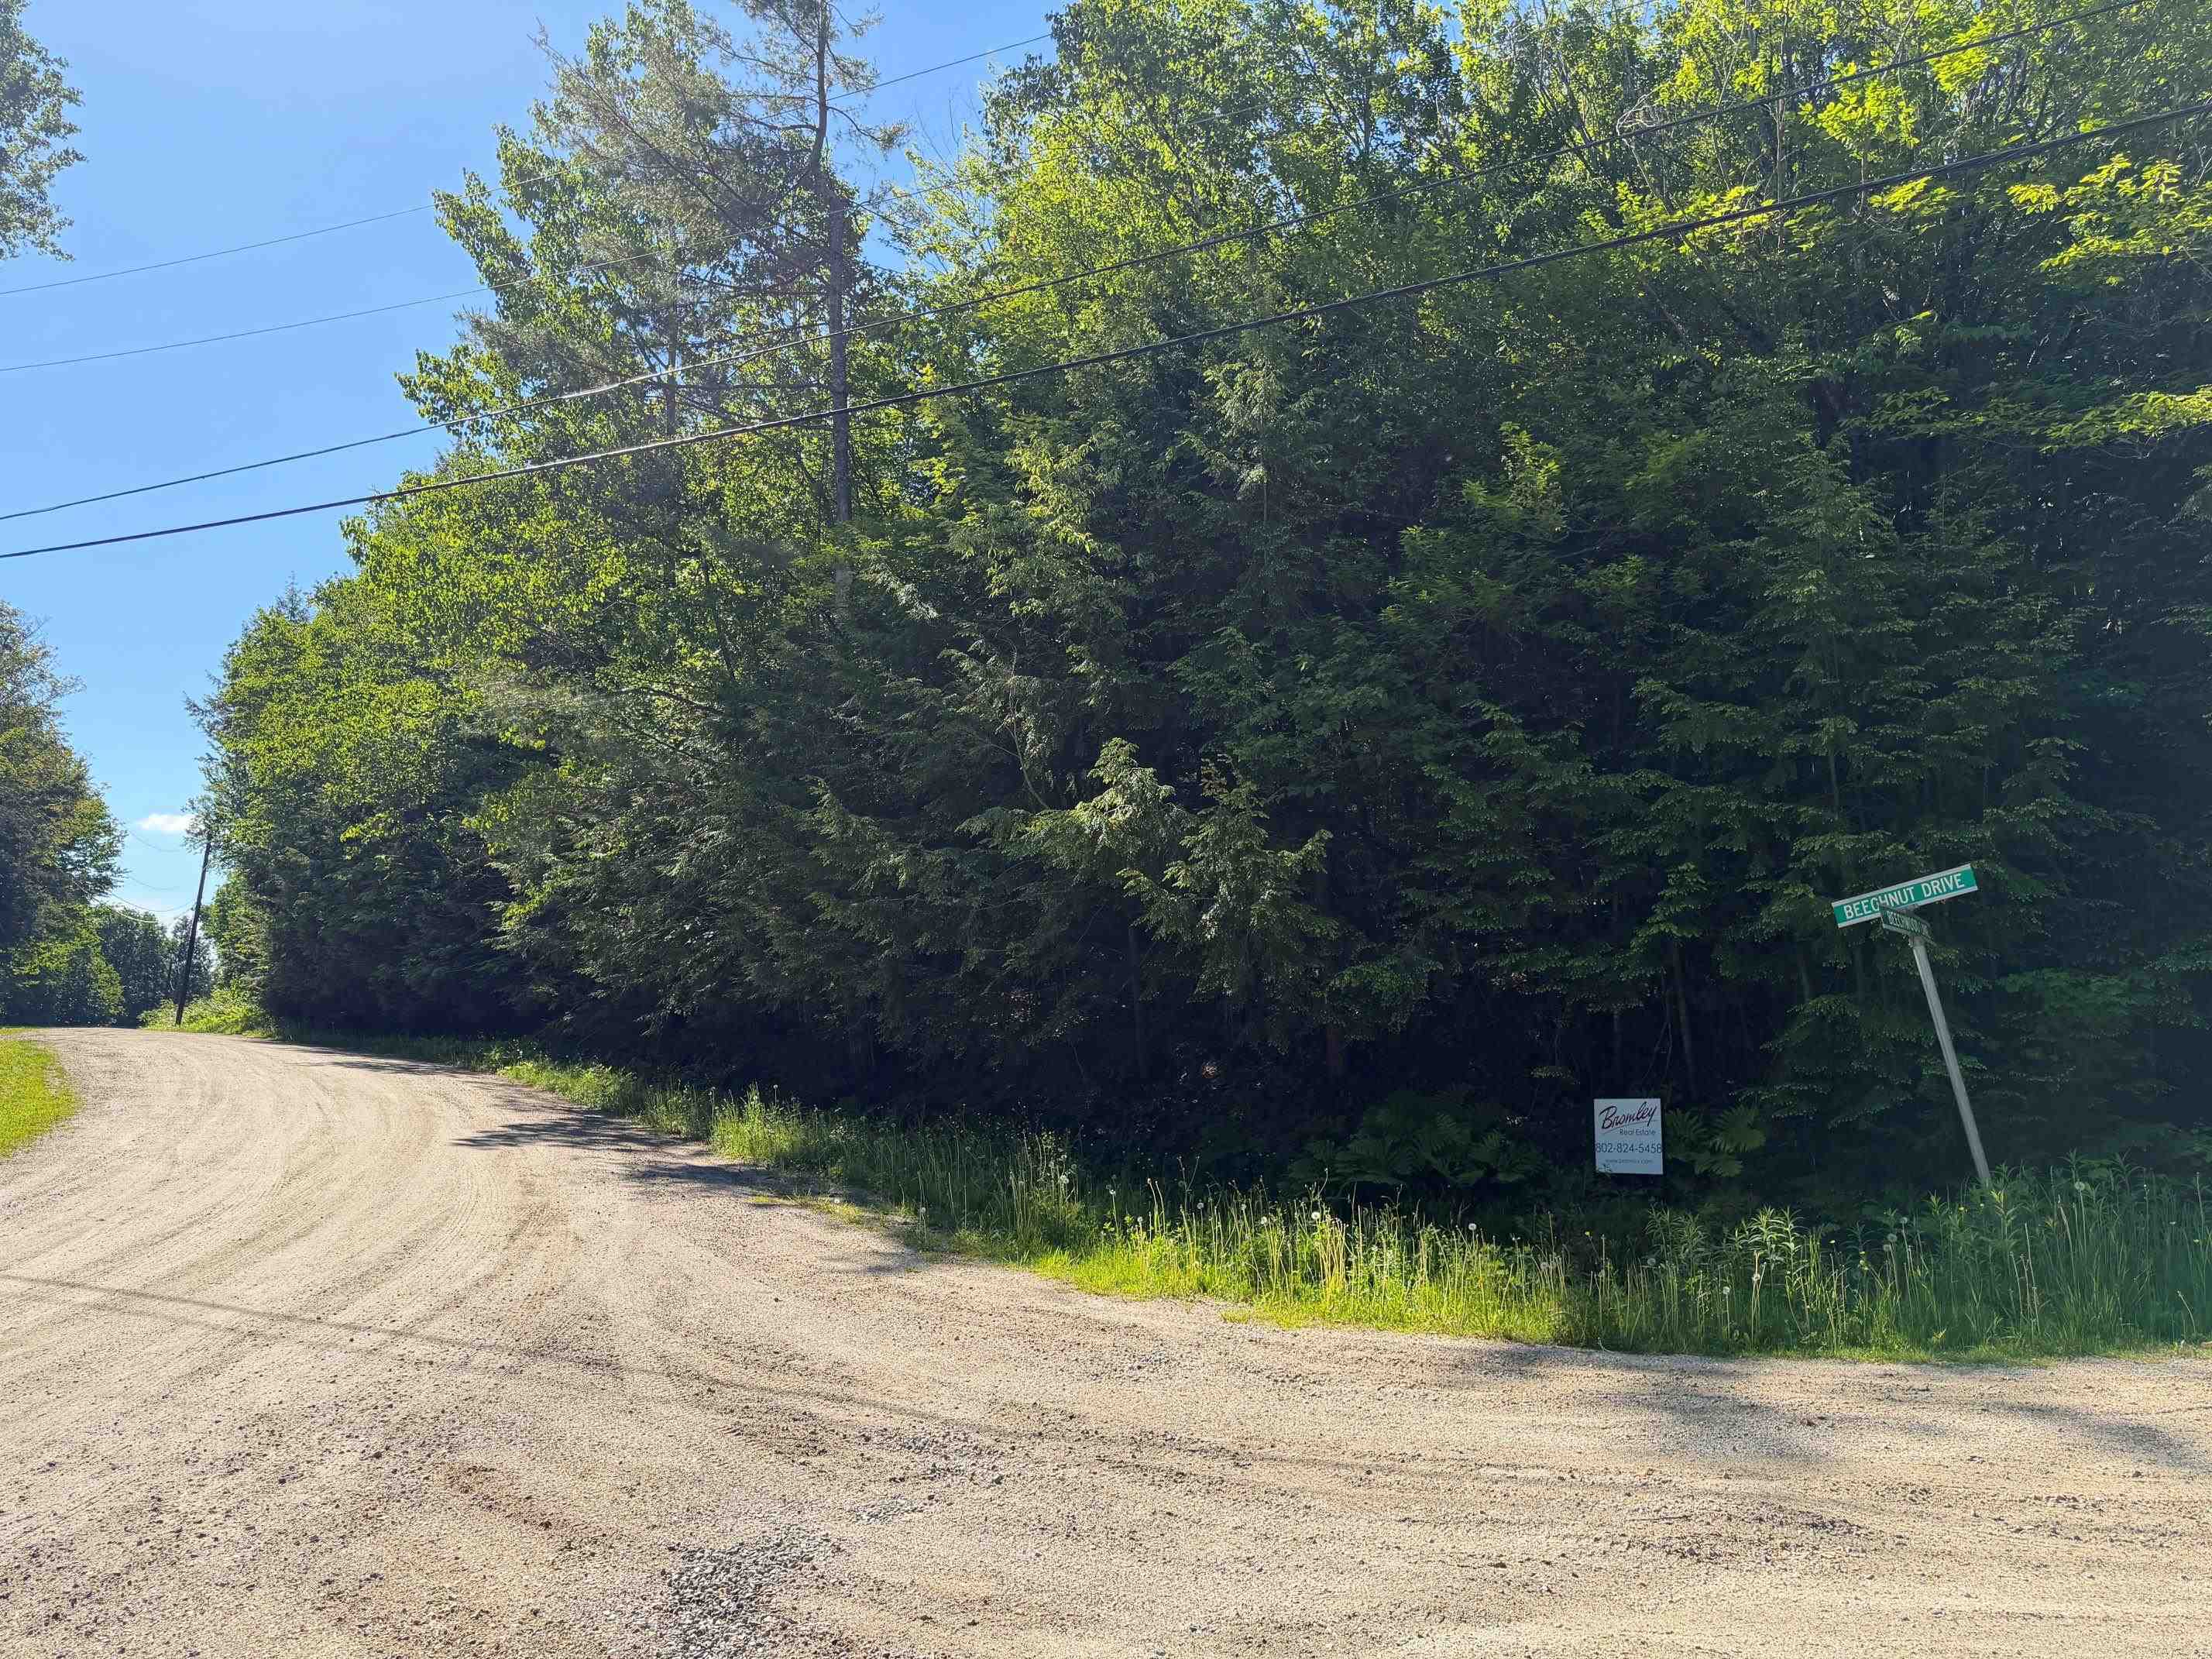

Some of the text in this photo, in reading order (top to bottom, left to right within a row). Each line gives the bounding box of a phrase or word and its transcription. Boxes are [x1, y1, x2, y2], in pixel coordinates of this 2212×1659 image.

[1843, 874, 1965, 919] BEECHNUT DRIVE
[1599, 1101, 1657, 1129] Bromley
[1595, 1142, 1662, 1153] 802-824-5458
